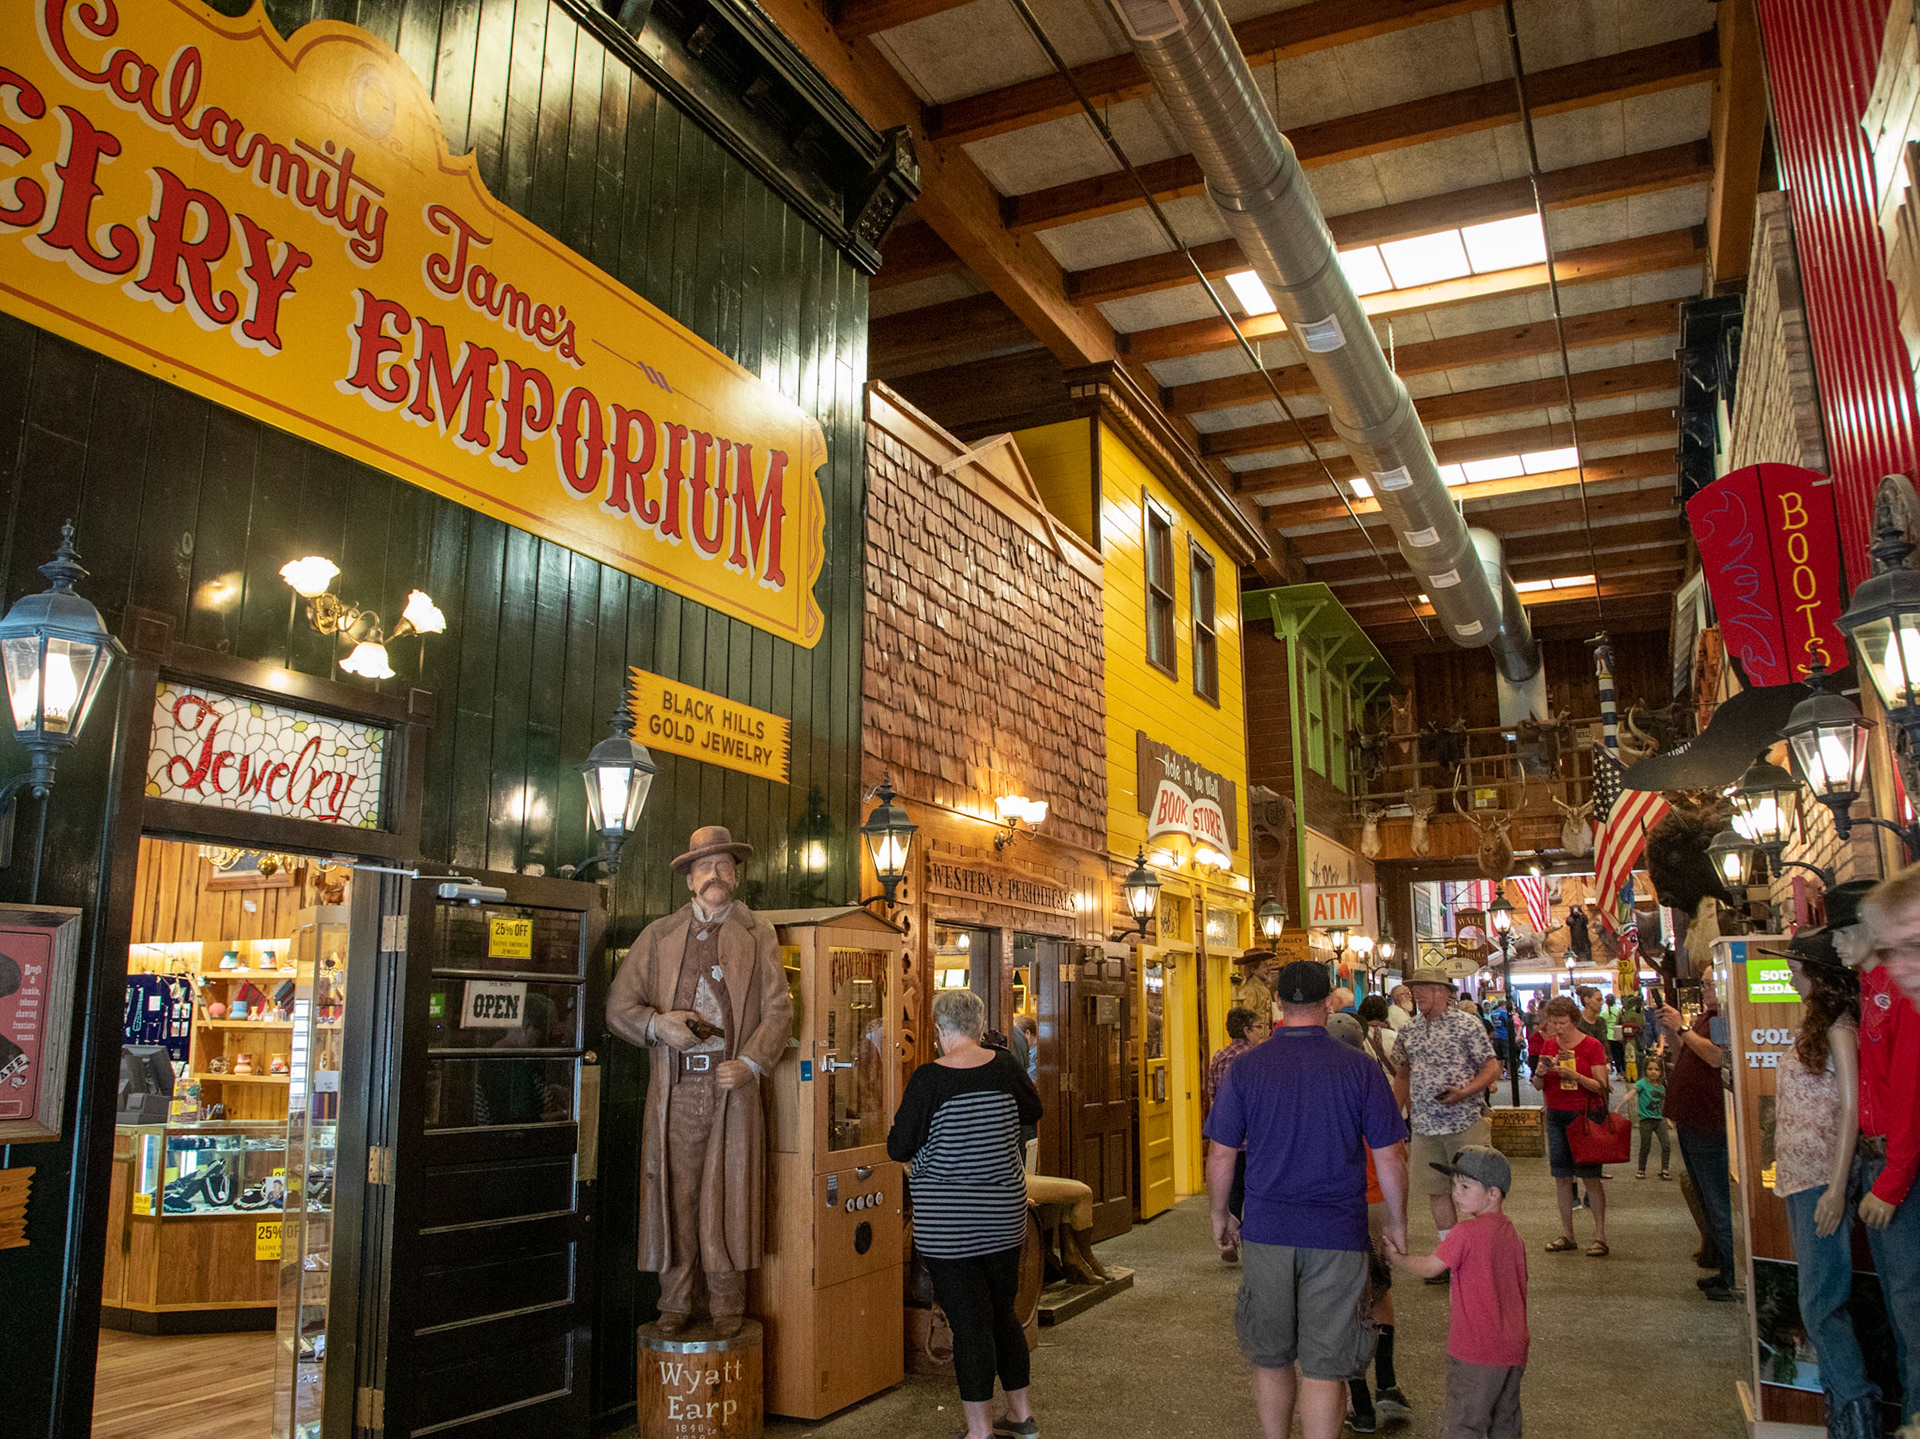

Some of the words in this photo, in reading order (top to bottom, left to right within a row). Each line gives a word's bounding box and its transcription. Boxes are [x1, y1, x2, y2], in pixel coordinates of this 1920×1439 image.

[40, 0, 389, 265] Calamity
[424, 204, 586, 367] Jane's
[342, 287, 789, 590] EMPORIUM
[1778, 491, 1831, 674] BOOTS
[663, 690, 715, 724] BLACK
[723, 709, 765, 740] HILLS
[650, 714, 695, 743] GOLD
[701, 731, 773, 766] JEWELRY
[166, 694, 358, 824] Jewelry
[1155, 752, 1181, 780] Hole
[1193, 767, 1204, 794] the
[1205, 776, 1220, 801] Wall
[1156, 789, 1189, 826] BOOK
[1192, 807, 1224, 843] STORE
[932, 862, 994, 897] WESTERN
[1008, 878, 1076, 913] PERIODICALS
[1313, 892, 1357, 920] ATM
[1457, 916, 1483, 925] WALL
[514, 924, 529, 937] OFF
[473, 993, 520, 1019] OPEN
[1751, 1029, 1797, 1045] COL
[0, 1057, 23, 1080] ANE
[1745, 1052, 1784, 1069] TH
[258, 1225, 283, 1240] 25%
[286, 1225, 301, 1239] OF
[659, 1359, 743, 1394] Wyatt
[667, 1395, 738, 1426] Earp
